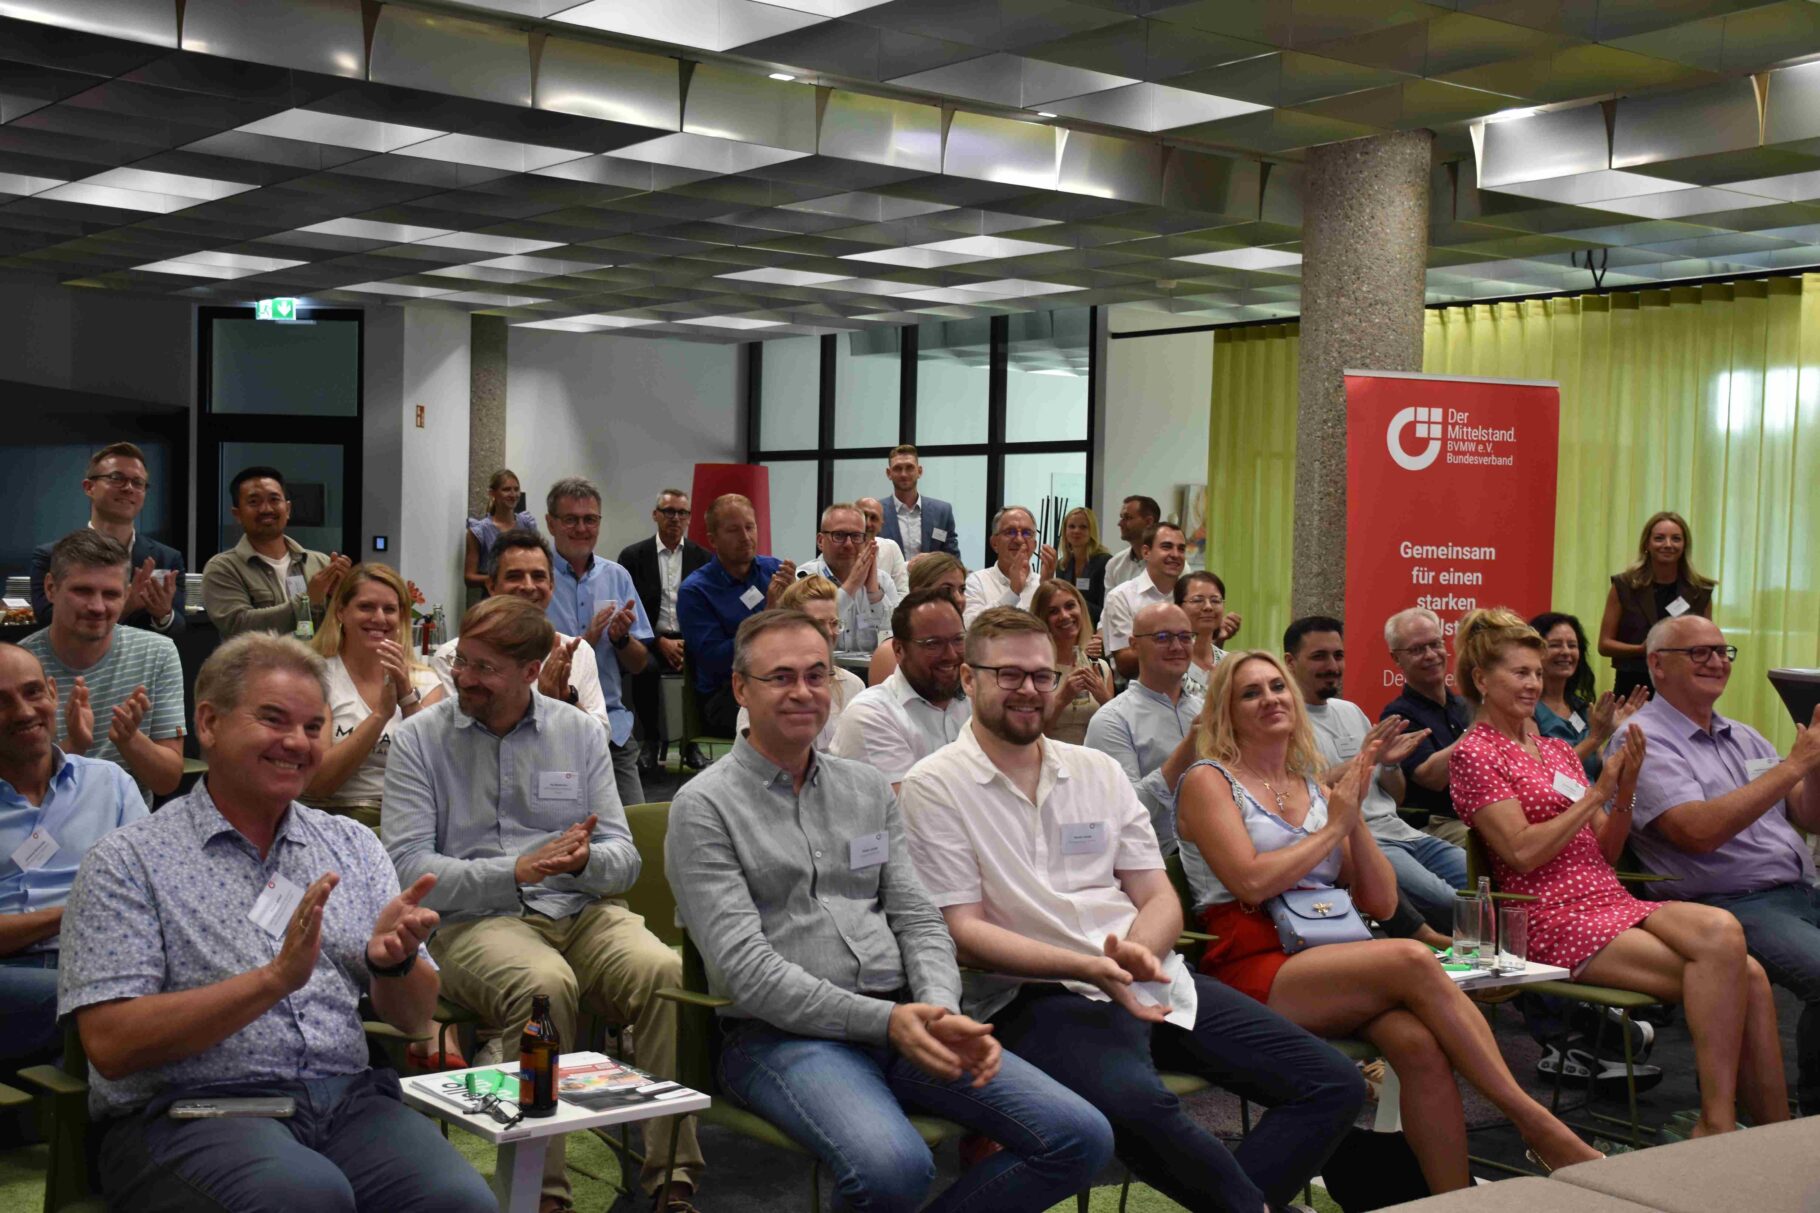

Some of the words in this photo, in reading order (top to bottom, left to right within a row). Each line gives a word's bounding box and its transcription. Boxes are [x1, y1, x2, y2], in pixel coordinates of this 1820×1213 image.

[1448, 408, 1469, 423] Der
[1447, 425, 1516, 442] Mittelstand.
[1447, 440, 1476, 452] BVMW
[1447, 452, 1513, 466] Bundesverband
[1400, 541, 1496, 560] Gemeinsam
[1412, 566, 1435, 584] für
[1439, 567, 1482, 585] einen
[1417, 593, 1476, 610] starken
